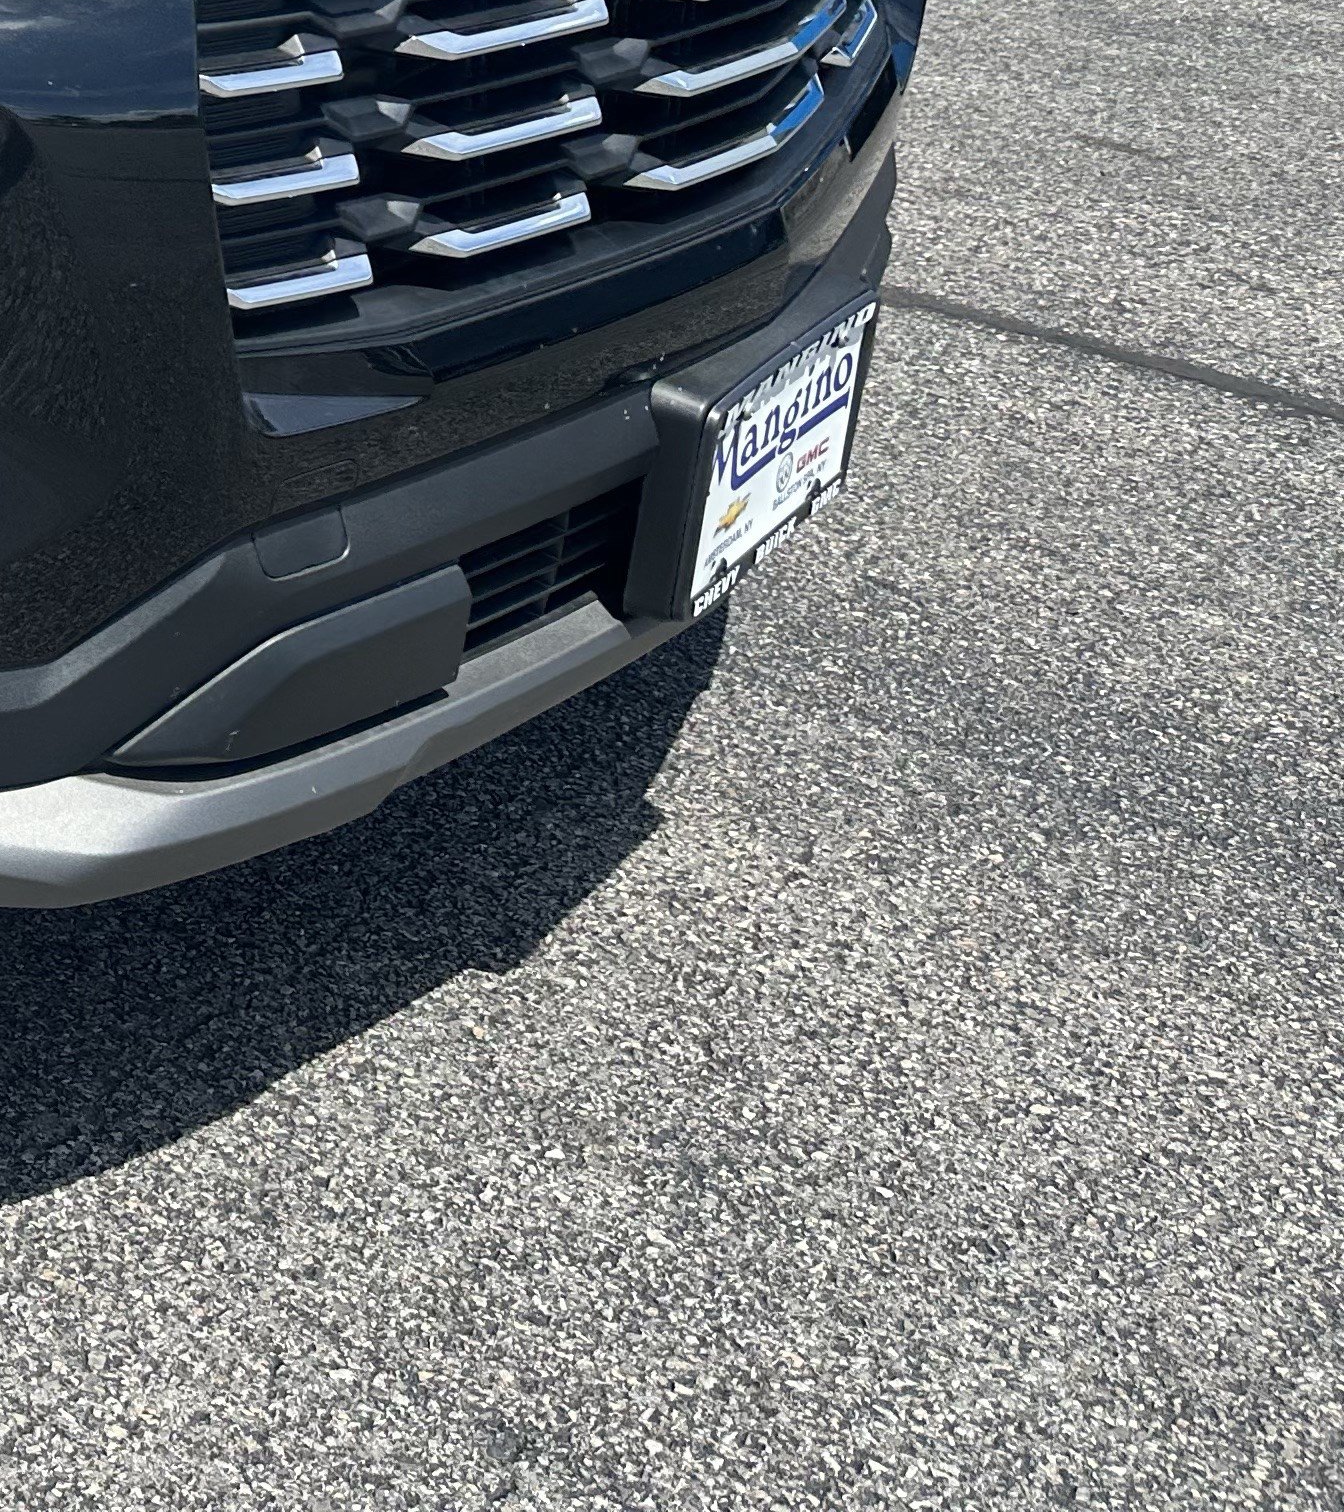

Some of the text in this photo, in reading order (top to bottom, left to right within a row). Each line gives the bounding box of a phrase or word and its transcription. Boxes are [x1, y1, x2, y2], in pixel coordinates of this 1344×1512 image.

[713, 353, 853, 490] Mangino
[796, 436, 830, 474] GMC
[692, 478, 843, 618] CHEVY BUICK GMC
